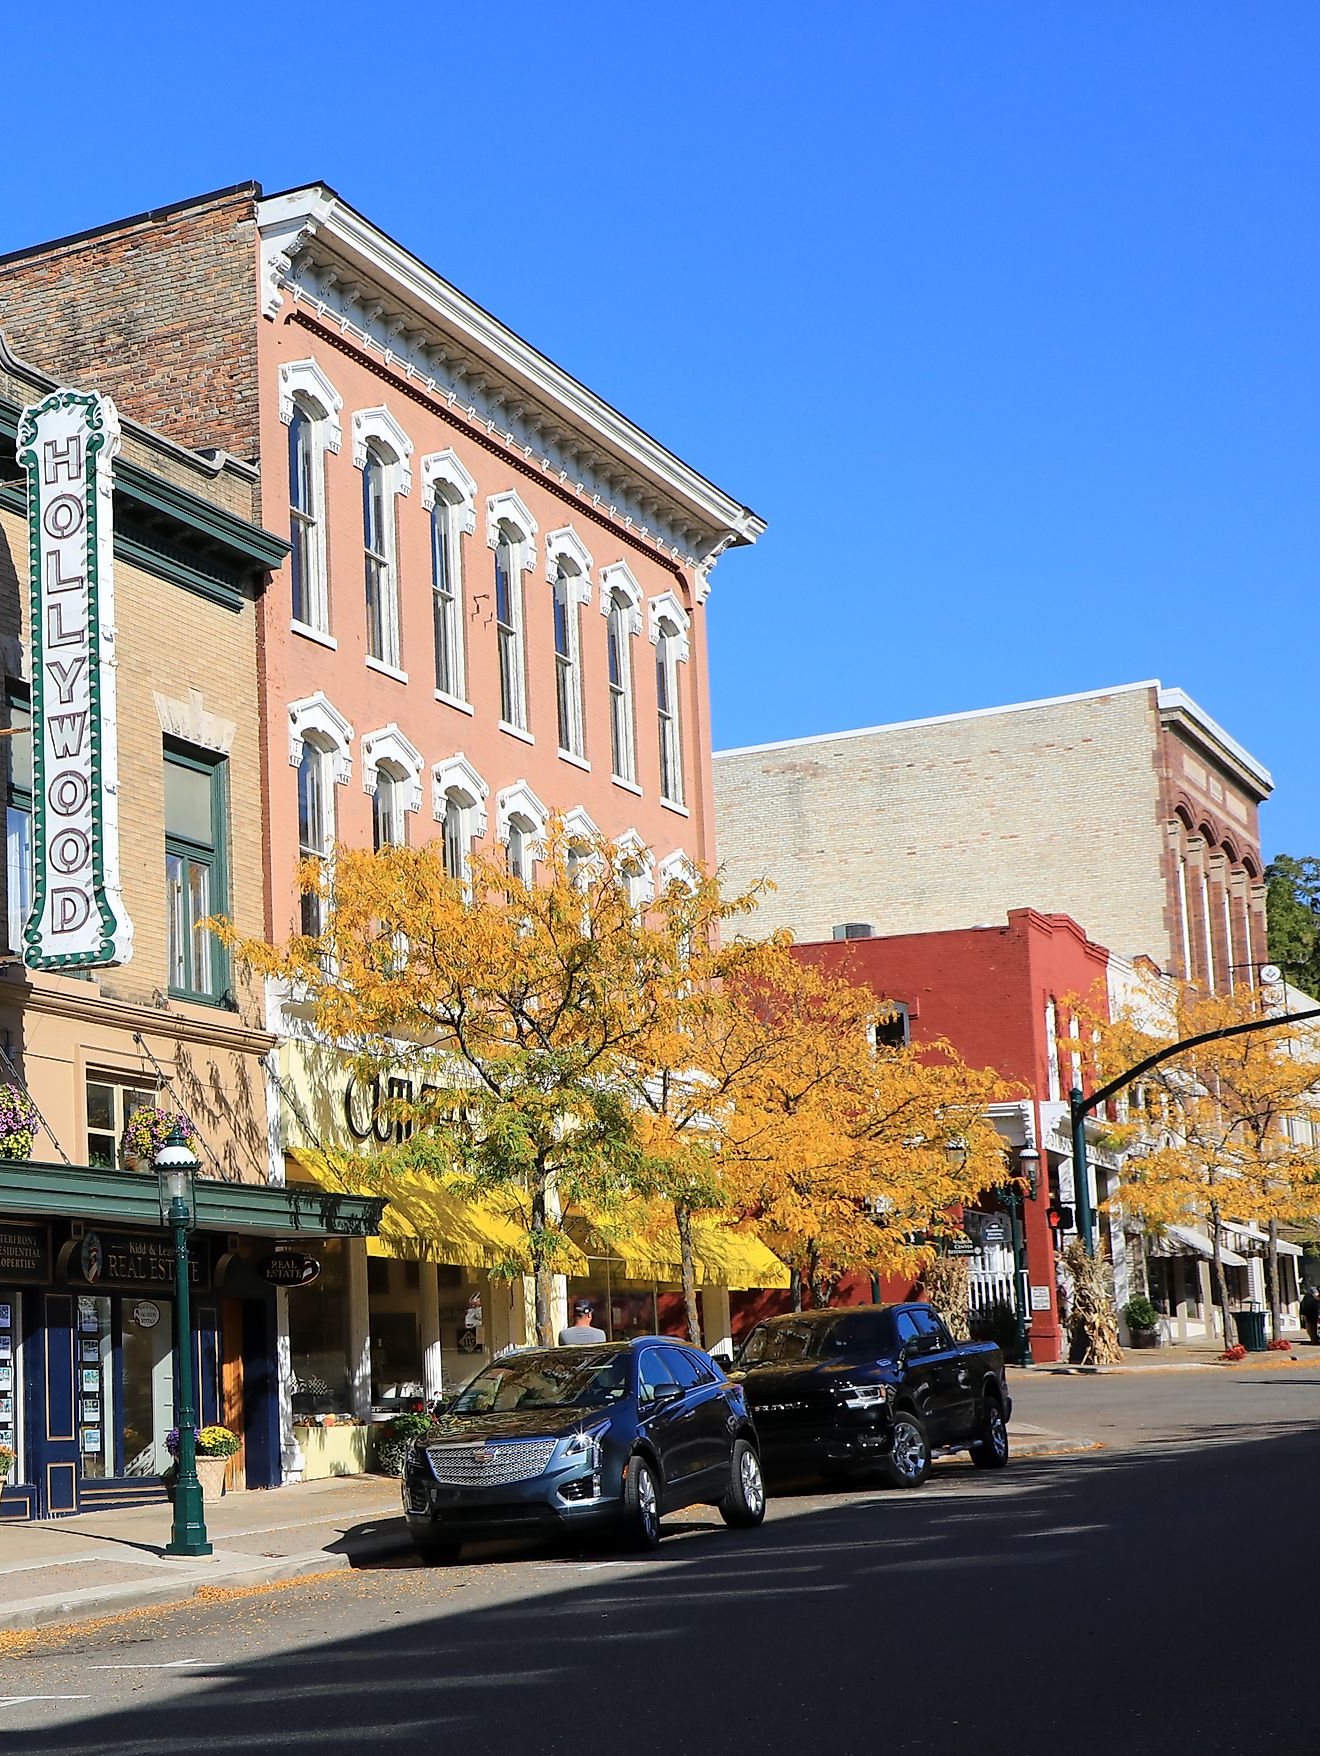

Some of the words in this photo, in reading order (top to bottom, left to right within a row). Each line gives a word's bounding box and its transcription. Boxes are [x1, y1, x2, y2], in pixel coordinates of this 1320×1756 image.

[43, 435, 91, 936] HOLLYWOOD
[129, 1242, 146, 1255] Kidd
[149, 1243, 157, 1256] &
[108, 1255, 146, 1279] REAL
[271, 1259, 297, 1269] REAL
[266, 1269, 302, 1279] ESTATE
